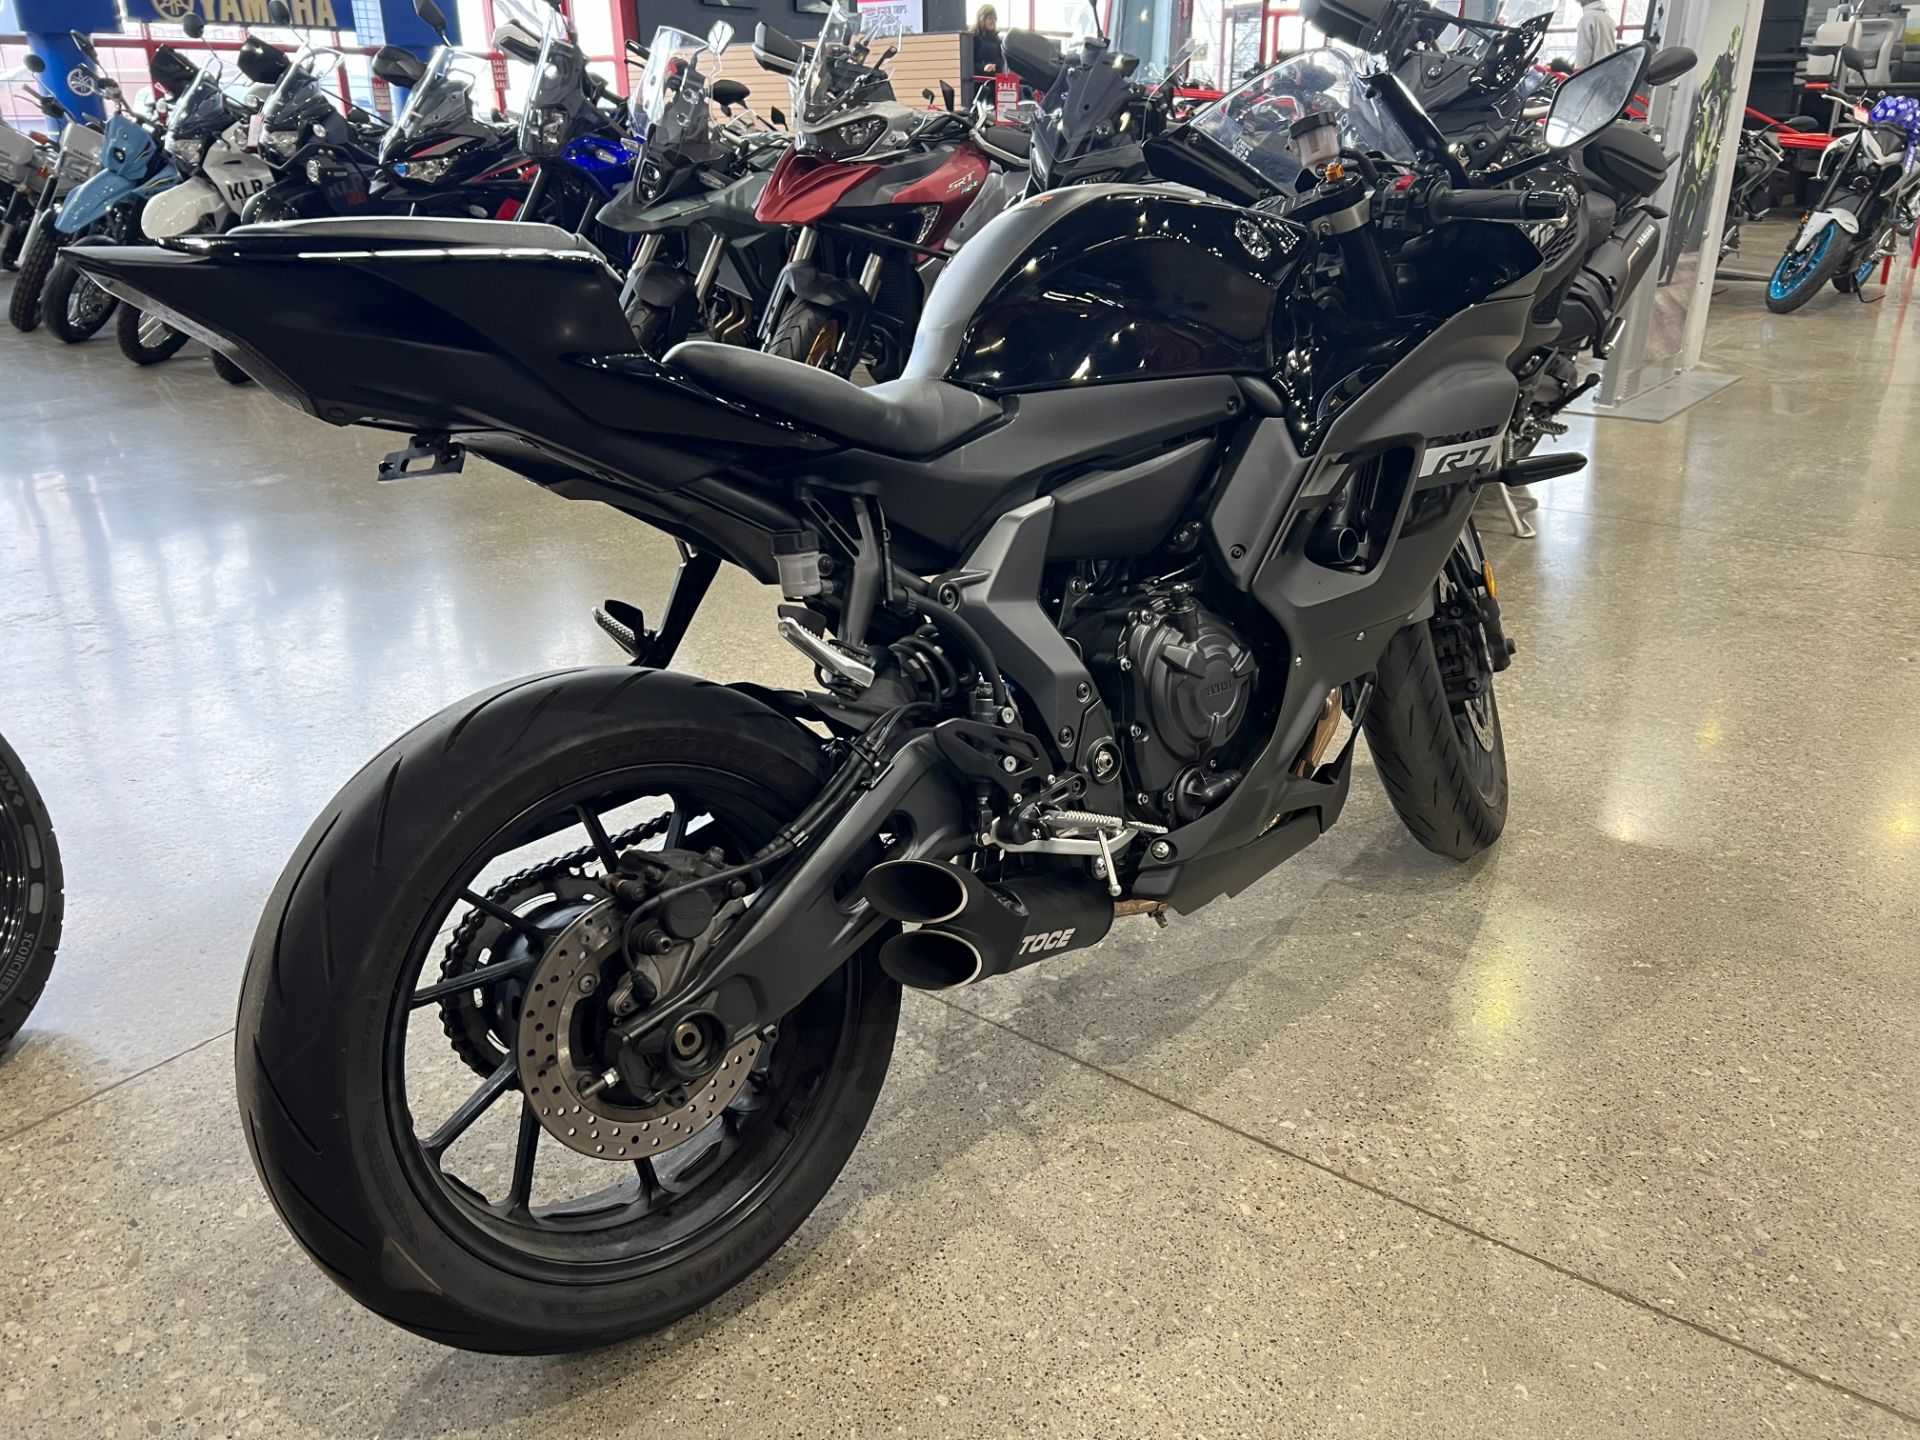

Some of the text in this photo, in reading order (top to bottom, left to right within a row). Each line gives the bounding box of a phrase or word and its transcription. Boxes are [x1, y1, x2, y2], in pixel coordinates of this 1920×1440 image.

[203, 0, 338, 27] YAMHA
[997, 82, 1017, 91] SALE
[227, 179, 263, 201] KLR
[328, 173, 366, 198] KLR
[1636, 224, 1656, 248] YAMAHA
[1432, 445, 1491, 475] R7
[1018, 927, 1076, 955] TOCE
[0, 932, 35, 991] SCORCHER
